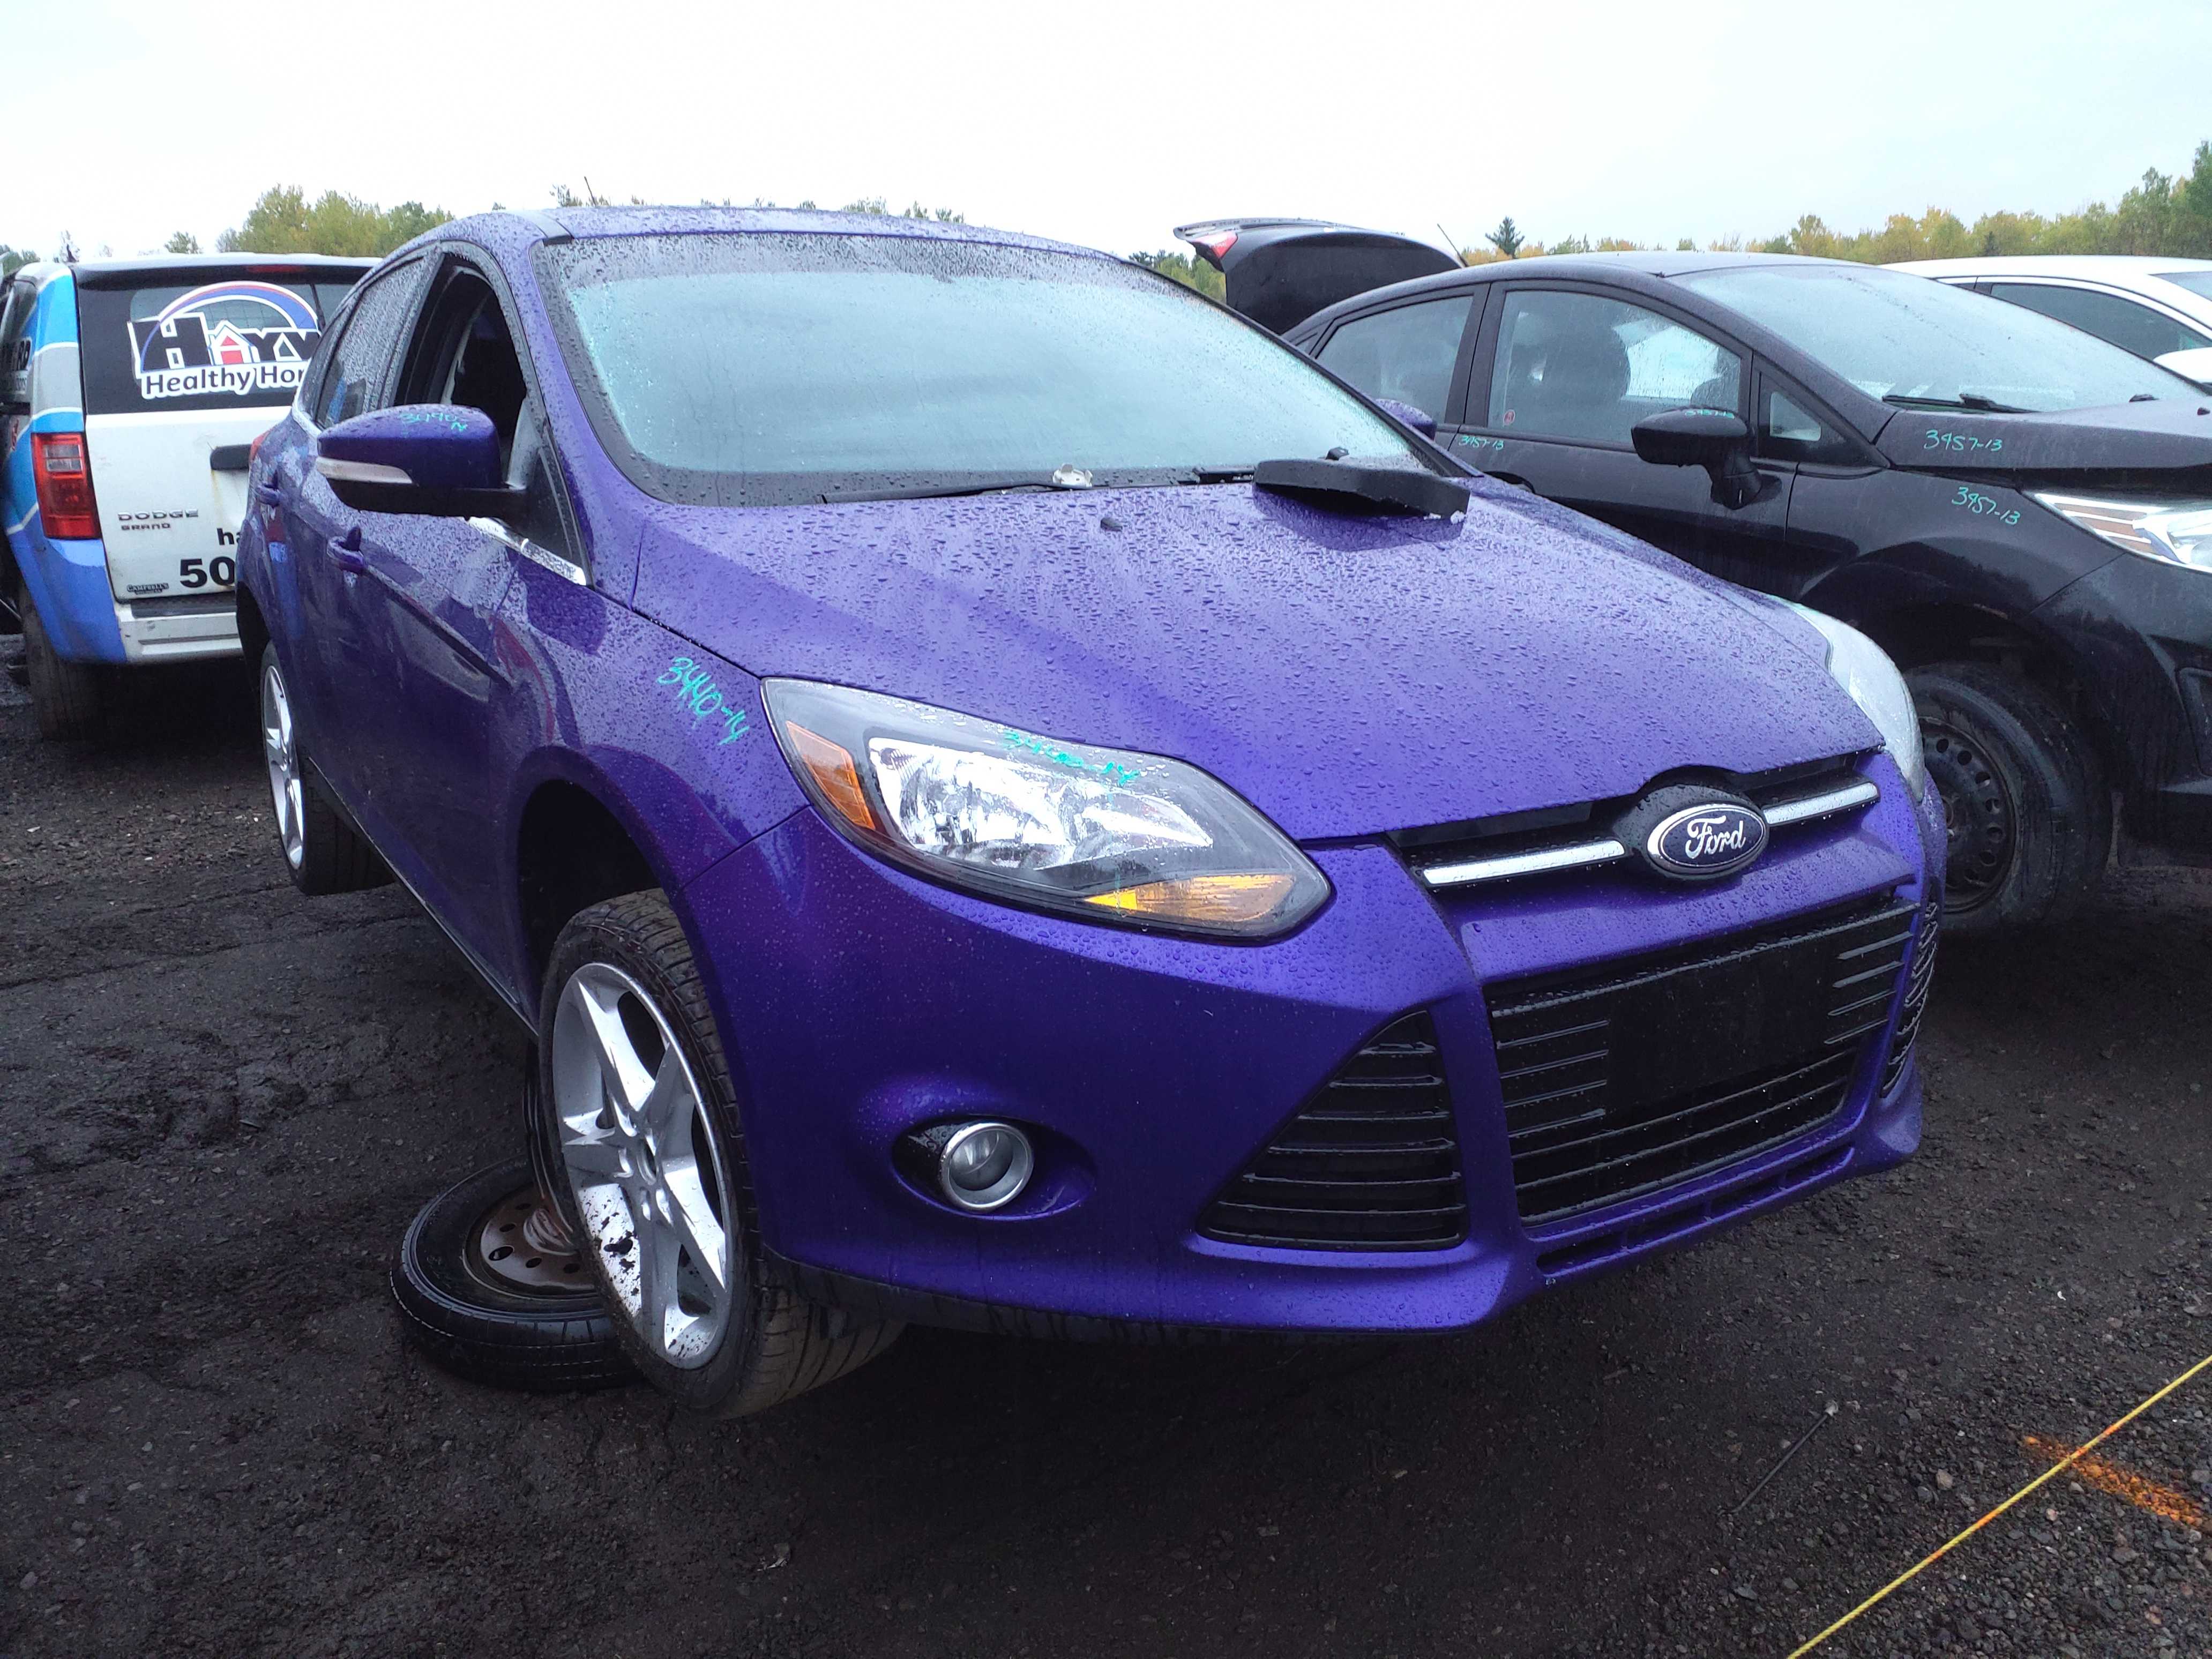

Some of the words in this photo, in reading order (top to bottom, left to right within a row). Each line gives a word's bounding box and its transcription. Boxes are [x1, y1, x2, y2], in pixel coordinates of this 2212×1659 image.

[146, 368, 250, 394] Healthy
[118, 509, 199, 521] DODGE
[121, 522, 171, 531] GRAND
[180, 556, 236, 588] 50
[1685, 815, 1746, 860] Ford
